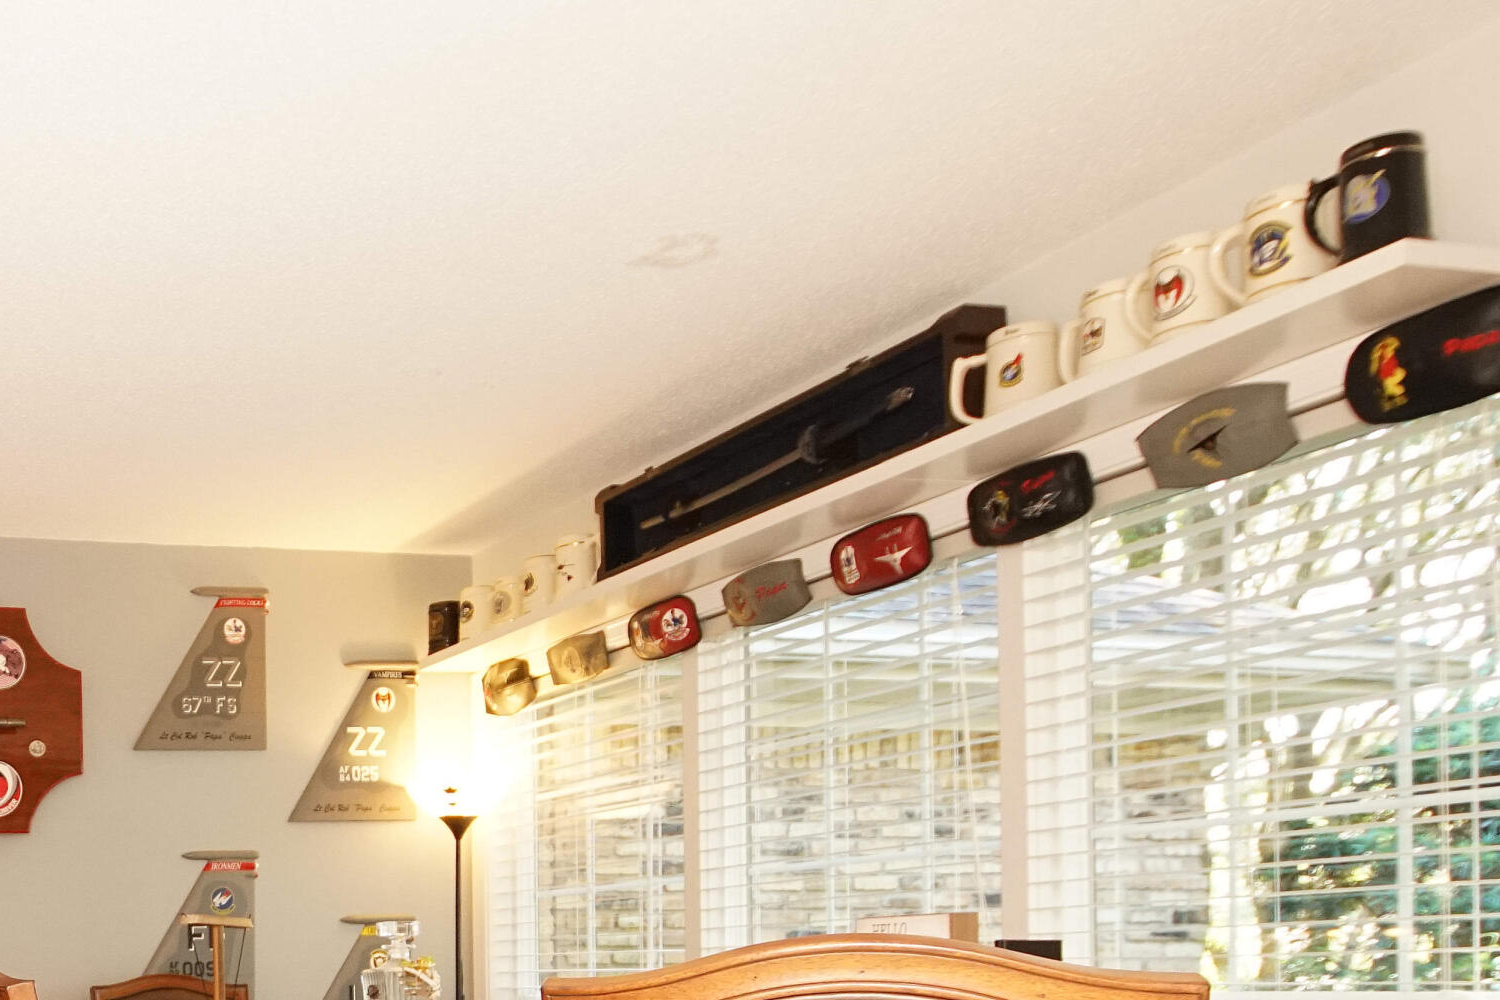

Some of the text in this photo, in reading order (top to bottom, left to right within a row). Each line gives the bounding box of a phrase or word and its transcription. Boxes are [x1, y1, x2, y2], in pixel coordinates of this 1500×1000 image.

[202, 657, 243, 687] ZZ
[216, 696, 237, 714] FS
[346, 726, 388, 757] ZZ
[351, 765, 380, 782] 025
[210, 862, 242, 871] IRONMEN
